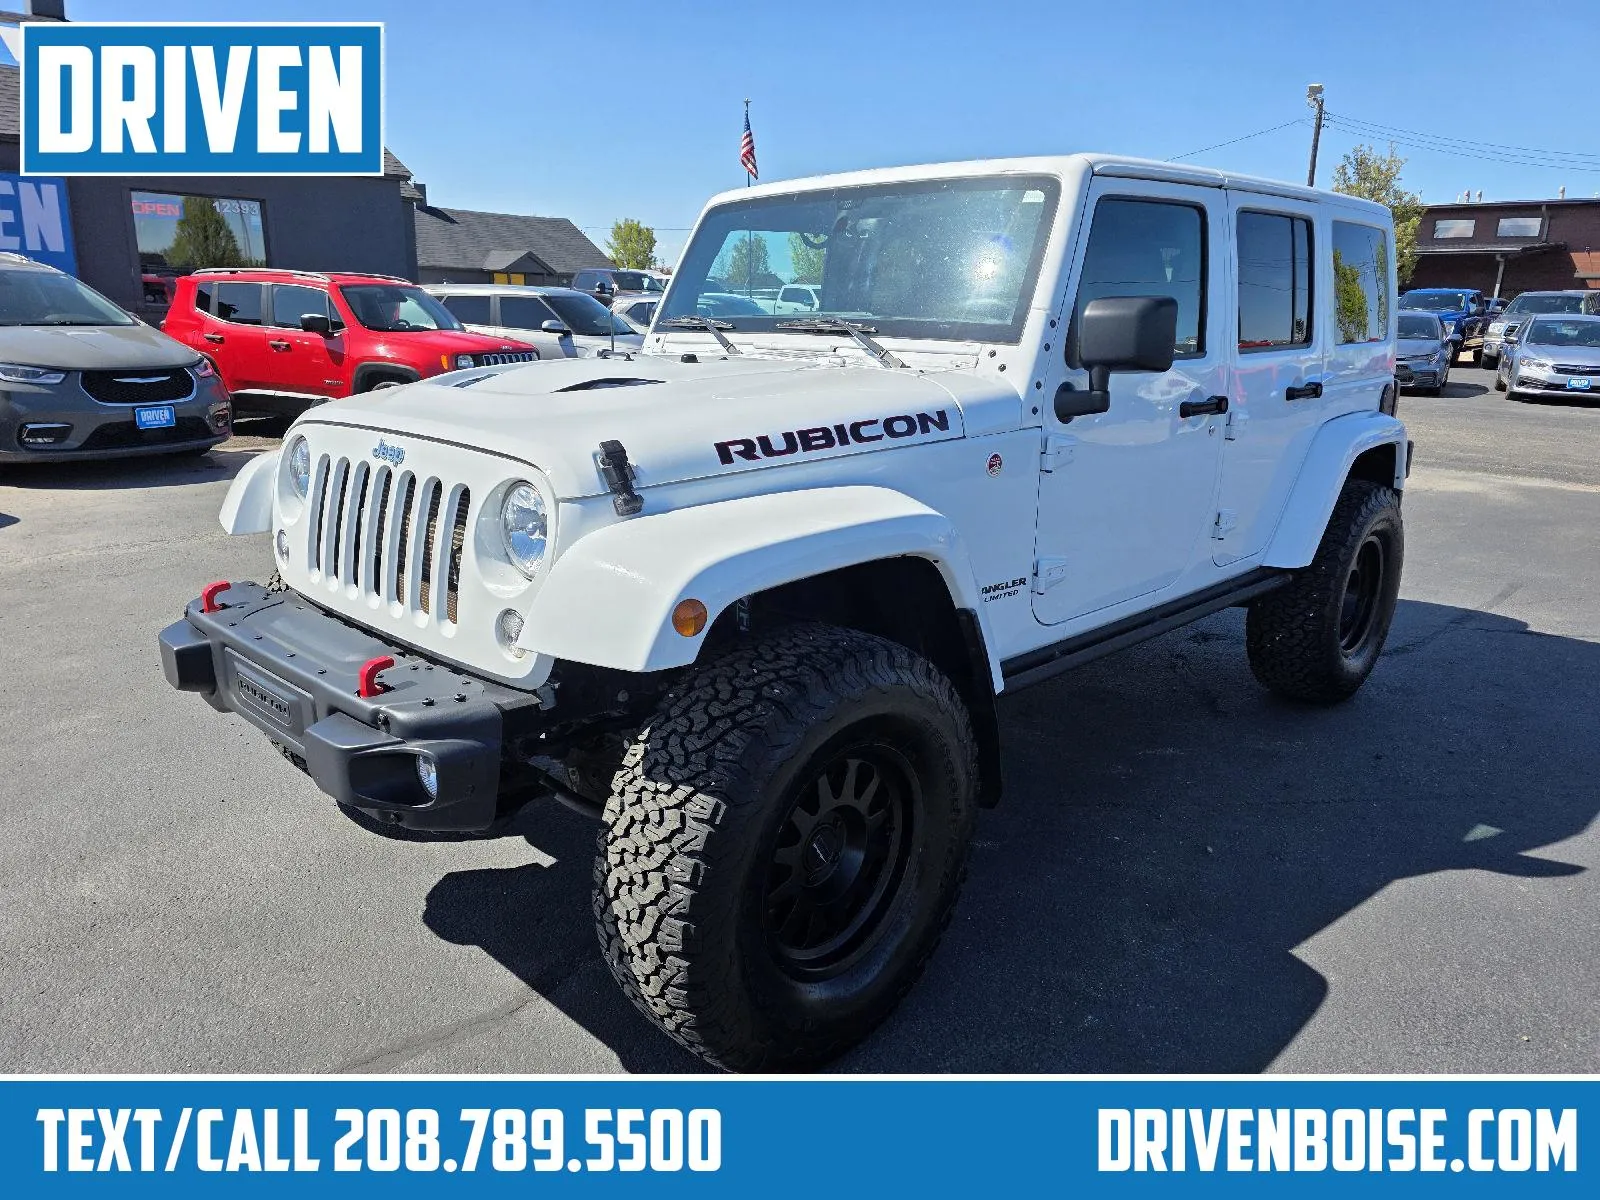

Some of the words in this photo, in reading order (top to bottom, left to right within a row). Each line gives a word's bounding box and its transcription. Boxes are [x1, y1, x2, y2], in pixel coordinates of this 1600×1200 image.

[132, 201, 180, 216] OPEN
[213, 200, 260, 215] 12393
[140, 409, 170, 421] DRIVEN
[714, 410, 949, 465] RUBICON
[372, 438, 405, 468] Jeep
[984, 589, 1019, 602] LIMITED
